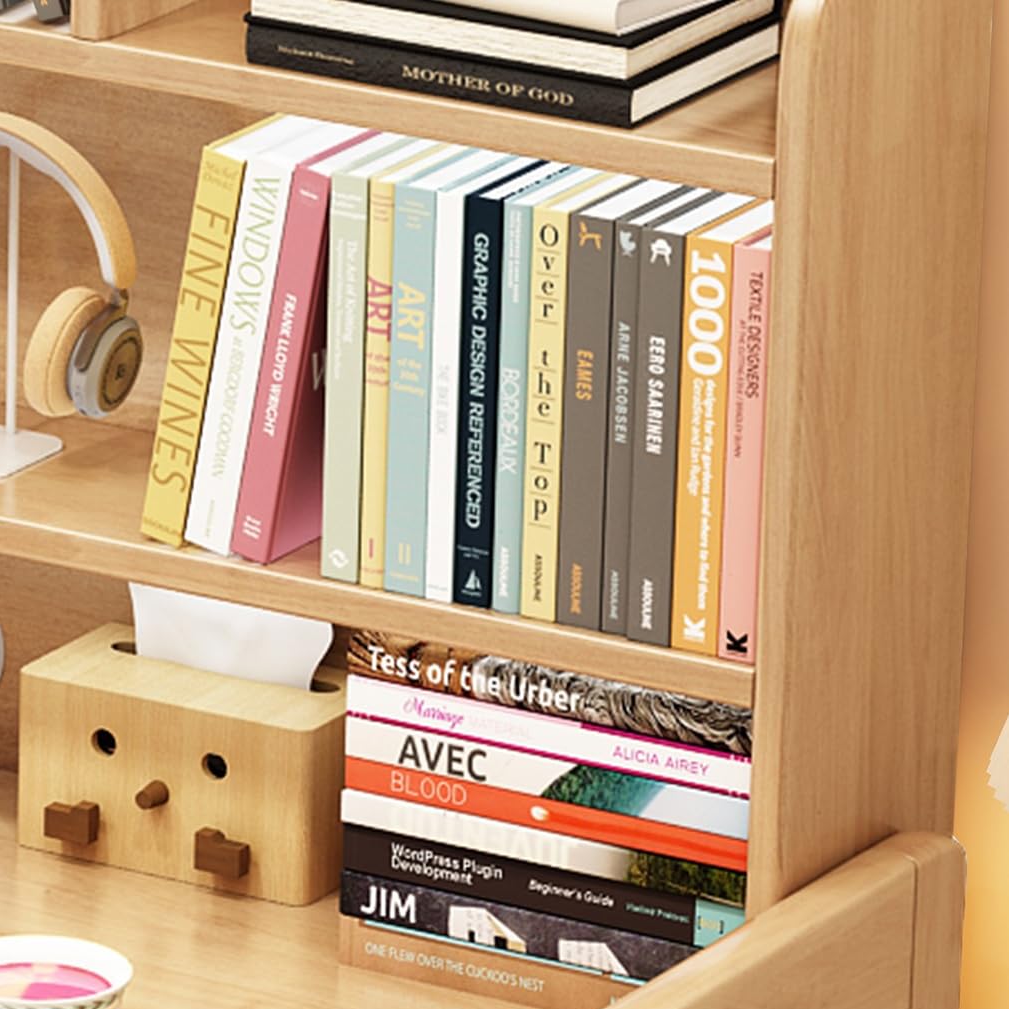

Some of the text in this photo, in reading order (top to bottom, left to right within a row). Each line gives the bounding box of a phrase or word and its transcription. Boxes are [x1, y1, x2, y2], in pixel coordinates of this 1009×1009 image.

[402, 65, 575, 106] MOTHER OF GOD
[179, 202, 231, 318] FINE
[230, 177, 280, 336] WINDOWS
[471, 232, 490, 320] GRAPHIC
[539, 223, 560, 319] Over
[366, 277, 393, 342] ART
[395, 281, 426, 351] ART
[687, 250, 726, 376] 1000
[745, 271, 764, 399] TEXTILE DESIGNERS
[263, 292, 298, 438] FRANK LLOYD WRIGHT
[468, 325, 487, 396] DESIGN
[537, 350, 557, 417] the
[575, 350, 594, 401] EAMES
[614, 321, 631, 444] ARNE JACOBSEN
[151, 337, 210, 495] WINES
[645, 335, 666, 456] EERO SAARINEN
[465, 401, 485, 529] REFERENCED
[368, 645, 420, 680] Tess
[427, 659, 457, 686] of
[460, 665, 500, 697] the
[403, 696, 464, 729] Marriage
[391, 771, 467, 806] BLOOD
[398, 734, 487, 782] AVEC
[612, 745, 710, 776] ALICIA AIREY
[391, 842, 504, 880] WordPress Plugin
[391, 856, 474, 886] Development
[528, 879, 614, 908] Beginner's Guide
[360, 885, 417, 923] JIM
[364, 941, 544, 993] ONE FLEW OVER THE CUCKOO'S NEST
